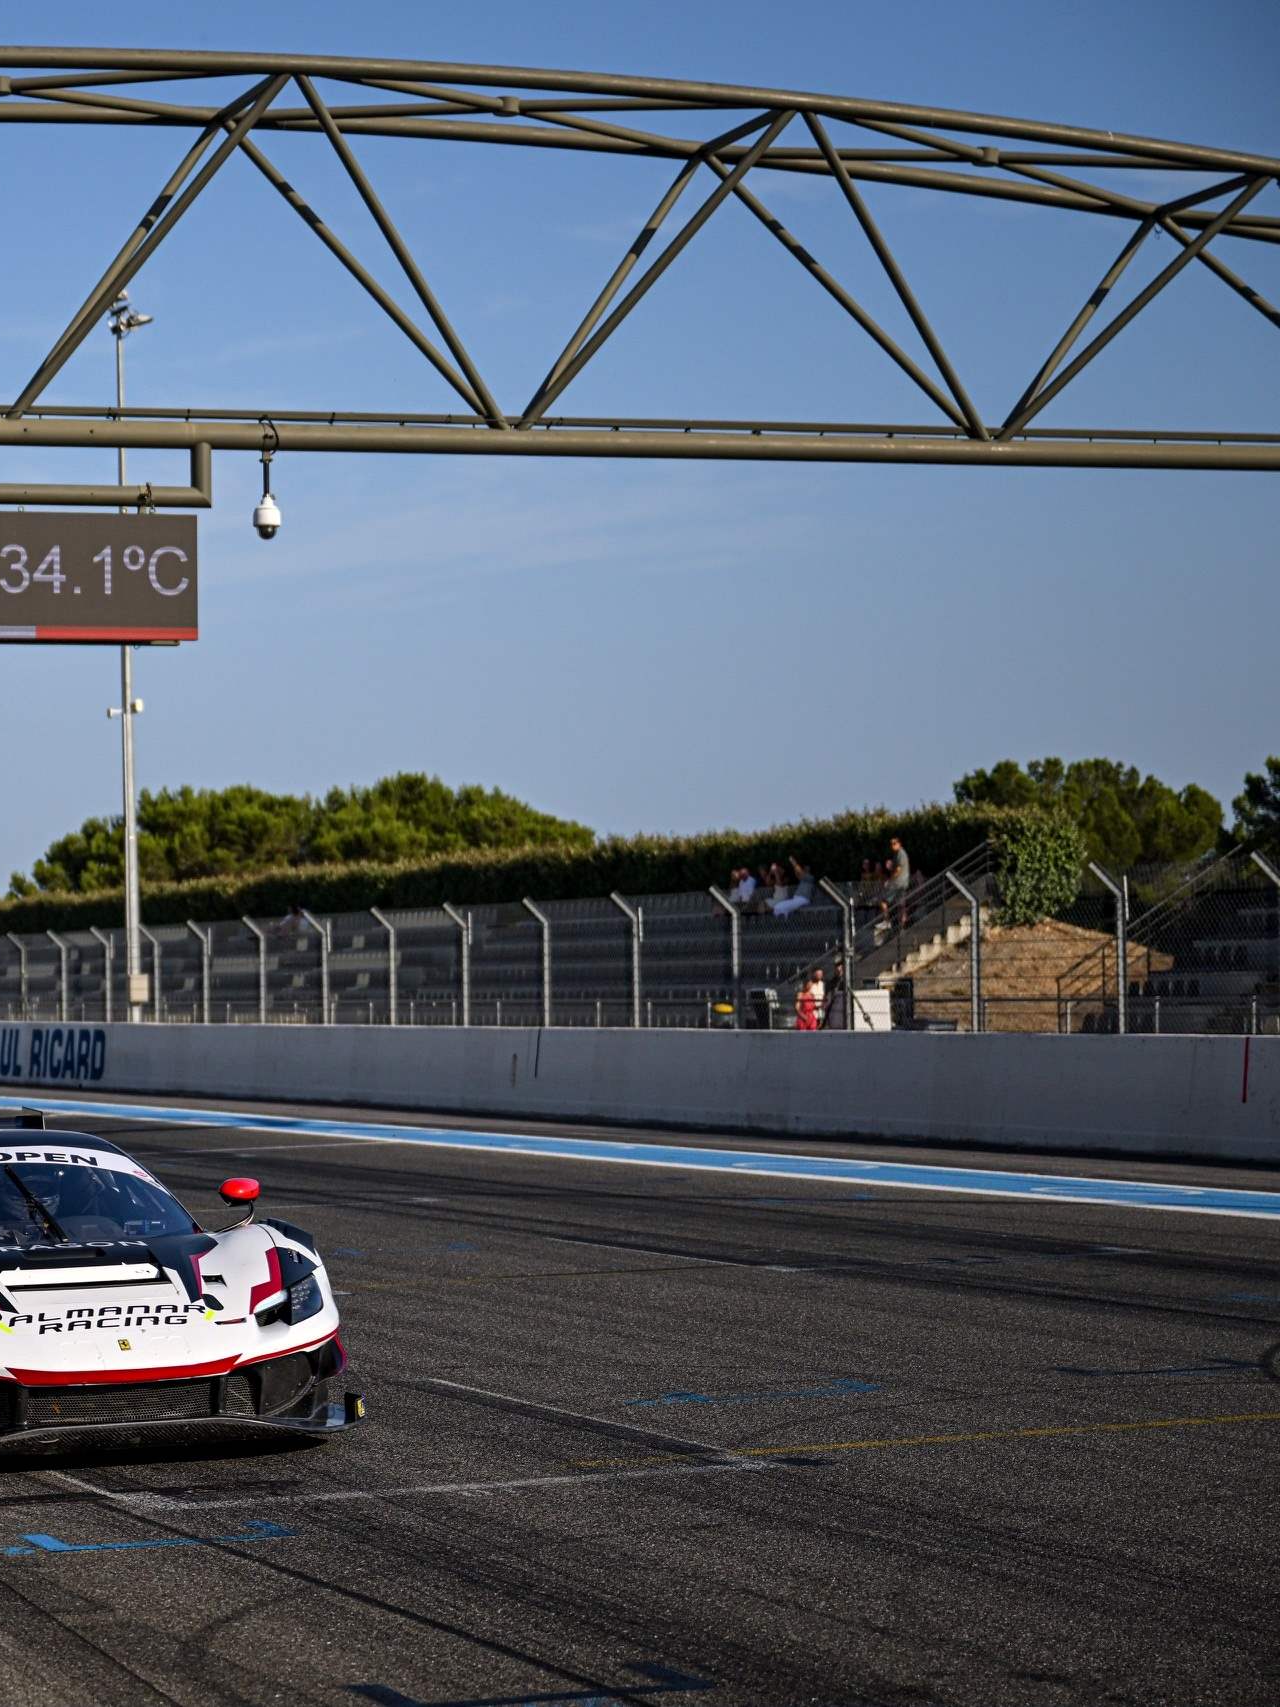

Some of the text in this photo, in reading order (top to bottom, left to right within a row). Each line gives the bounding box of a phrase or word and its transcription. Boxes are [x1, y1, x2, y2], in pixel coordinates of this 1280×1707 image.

[28, 1028, 107, 1081] RICARD
[8, 1303, 206, 1328] ALMANAR
[38, 1315, 189, 1335] RACING
